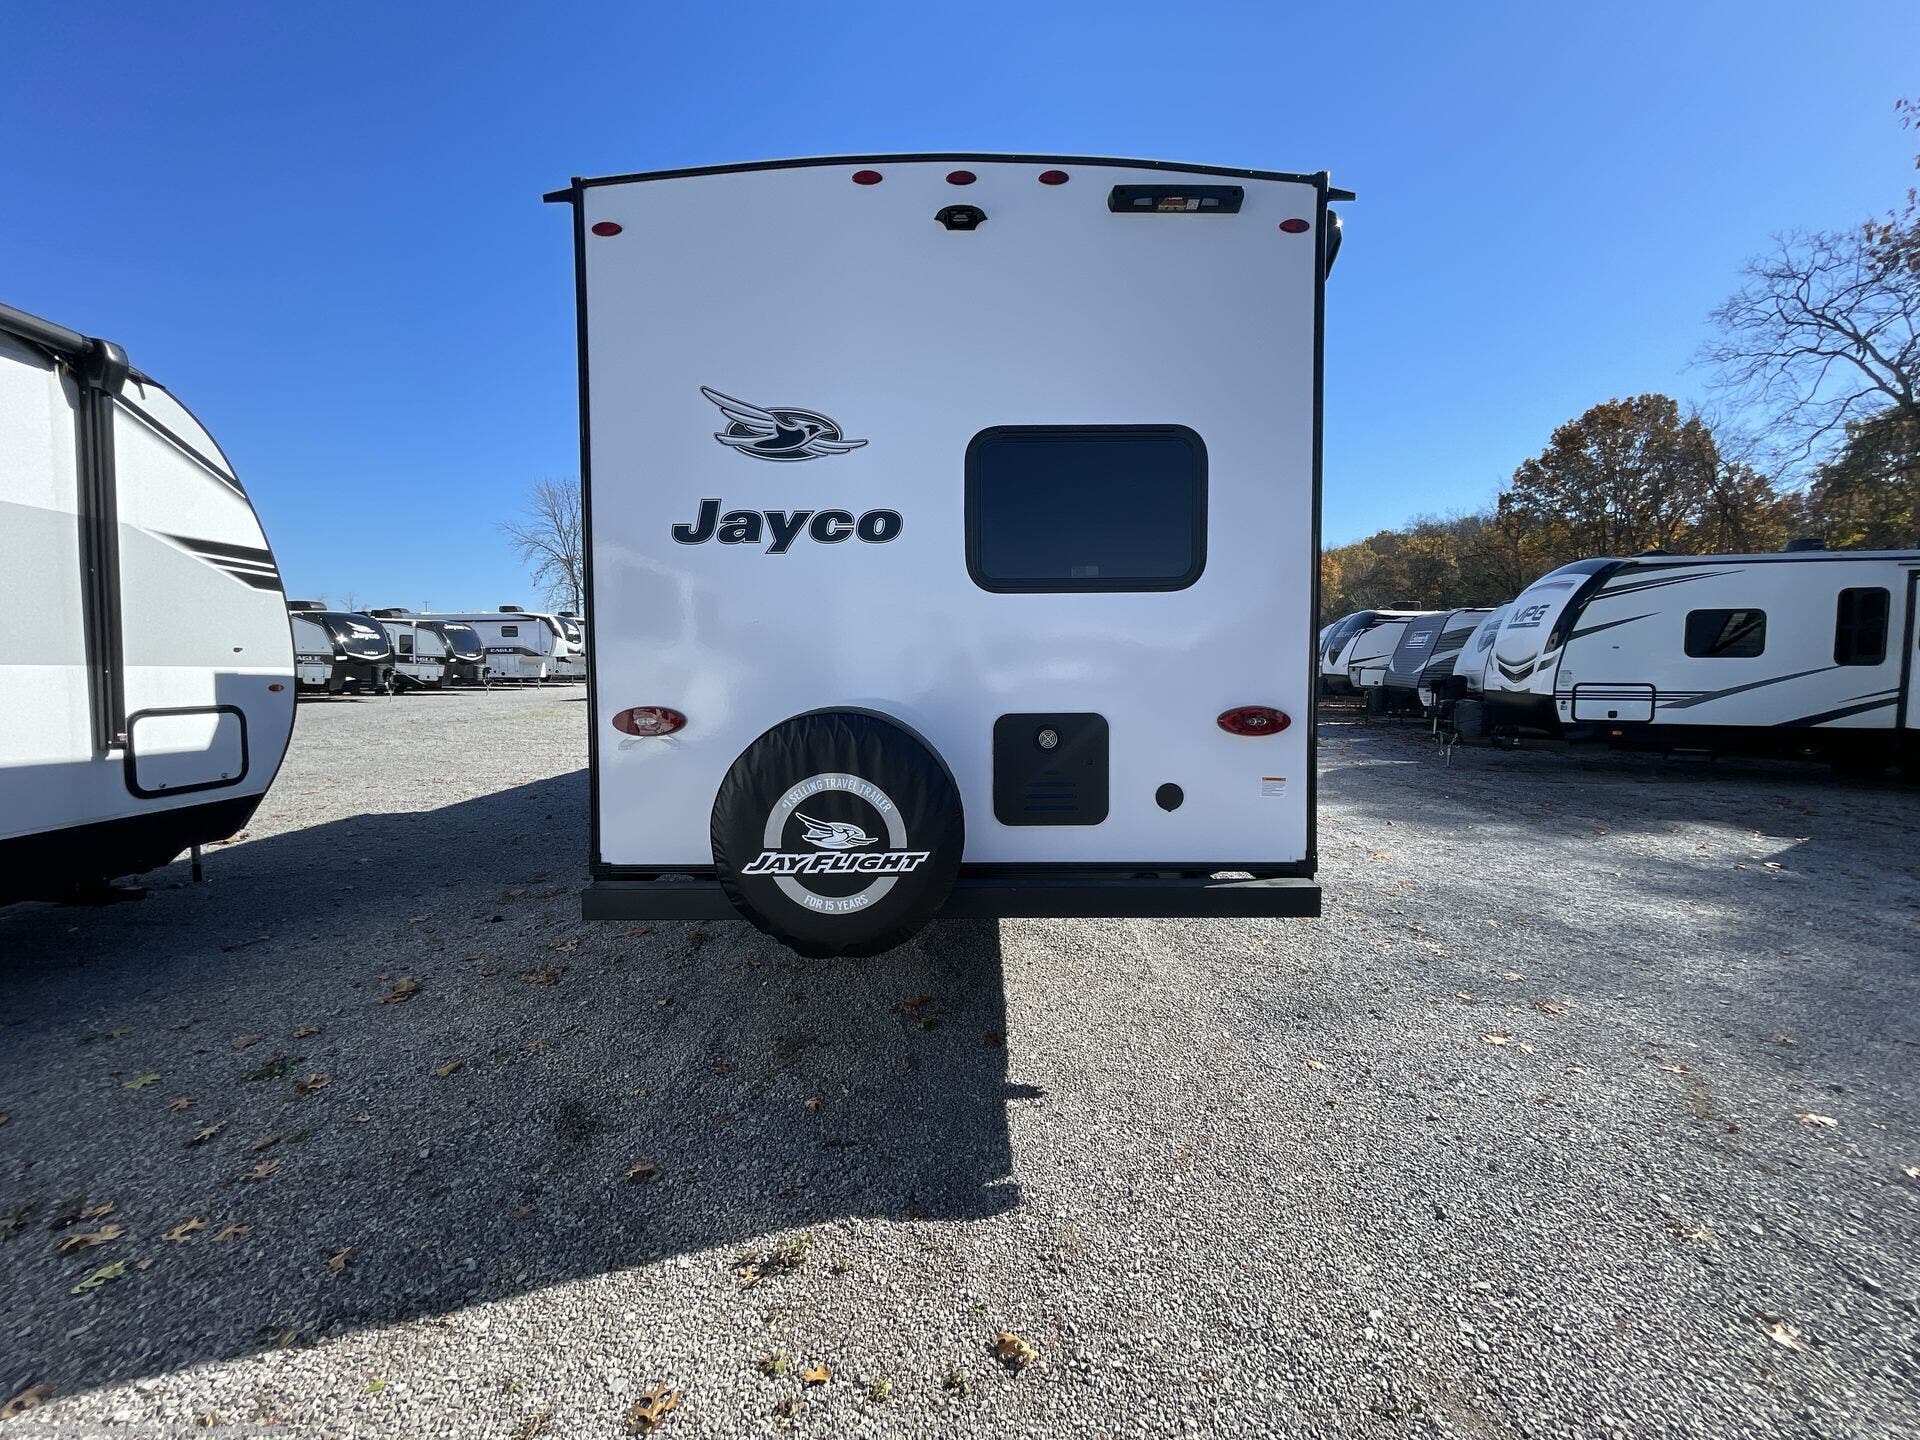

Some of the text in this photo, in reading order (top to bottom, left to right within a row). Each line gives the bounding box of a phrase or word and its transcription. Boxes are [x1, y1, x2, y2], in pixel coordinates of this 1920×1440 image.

[671, 497, 904, 555] Jayco
[1510, 604, 1551, 623] MPG
[789, 779, 823, 803] SELLING
[824, 778, 857, 792] TRAVEL
[860, 783, 892, 813] TRAILER
[804, 894, 869, 911] FOR 15 YEARS
